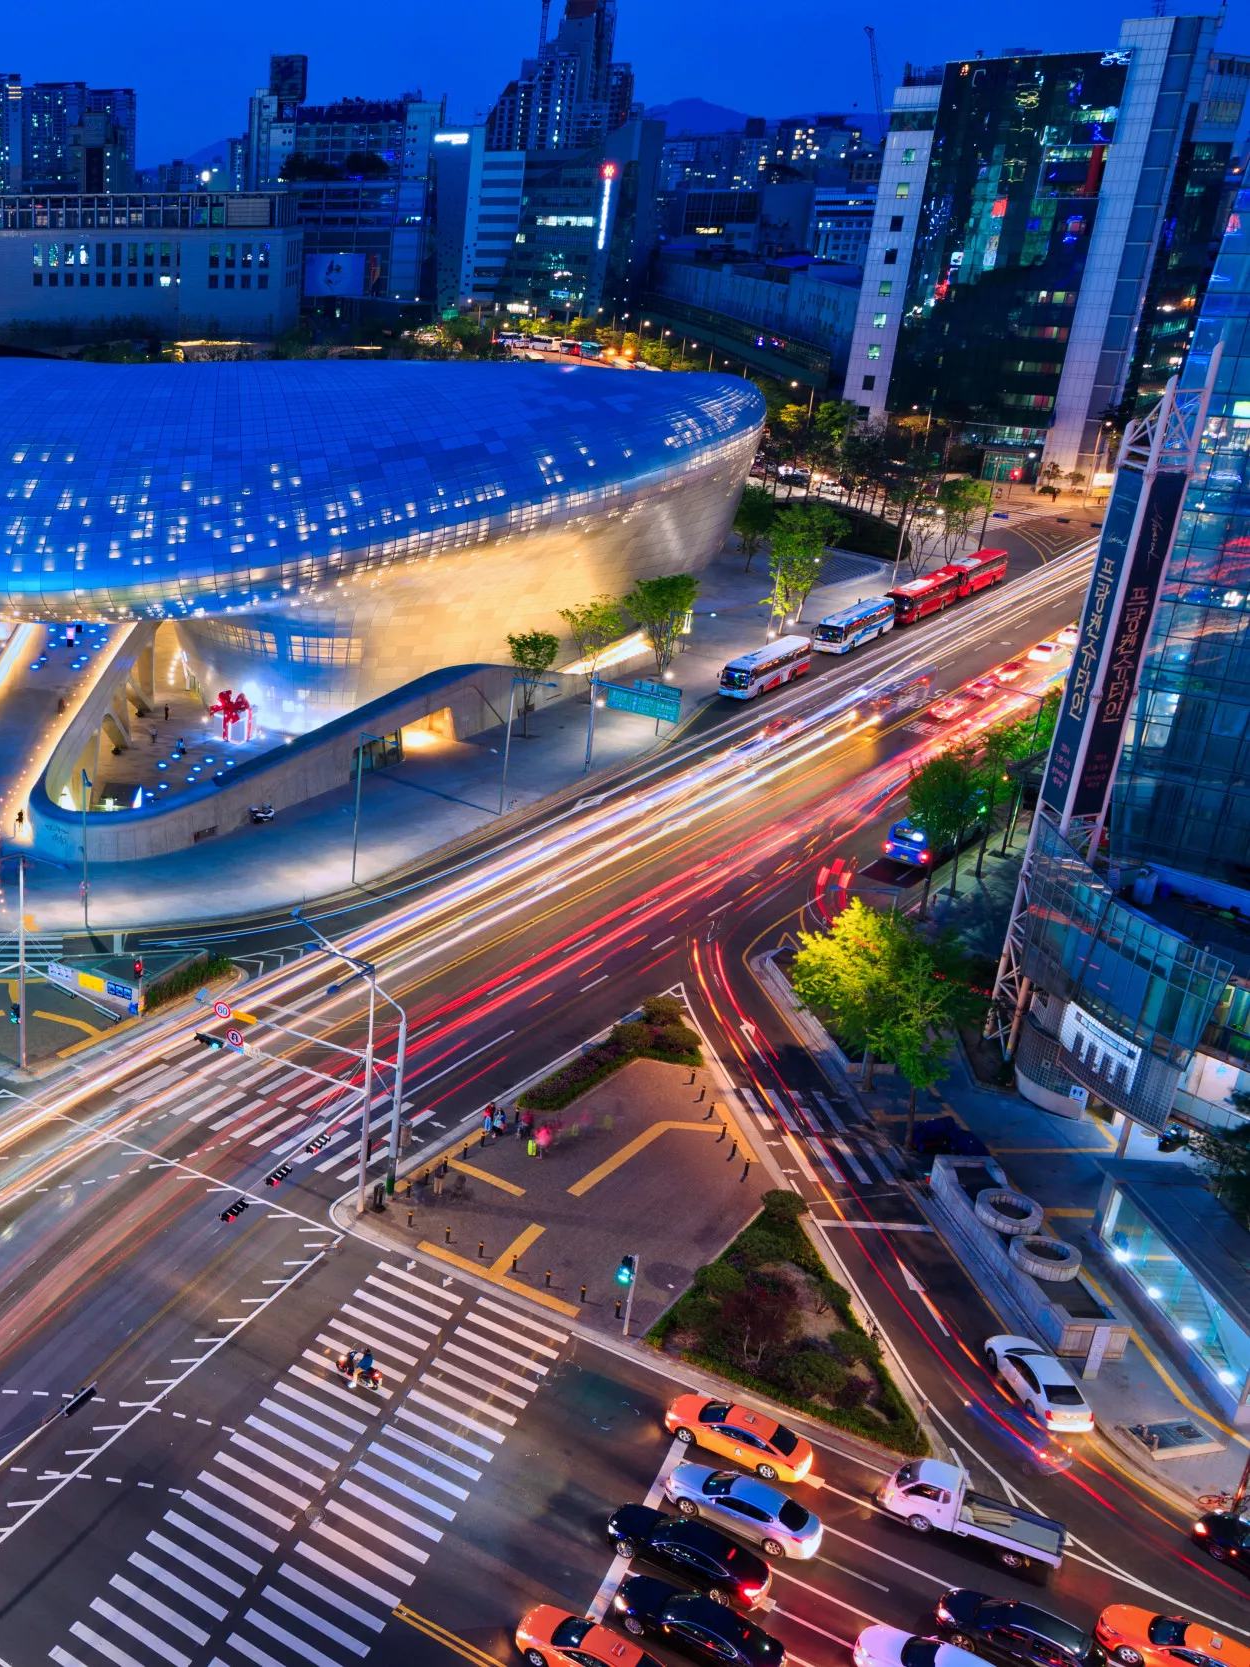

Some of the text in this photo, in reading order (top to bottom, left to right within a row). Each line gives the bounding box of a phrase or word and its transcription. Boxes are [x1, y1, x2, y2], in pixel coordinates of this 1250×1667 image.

[1069, 557, 1115, 721] 프랑켄슈타인
[1102, 587, 1148, 723] 프랑켄슈타인
[217, 1005, 228, 1016] 60
